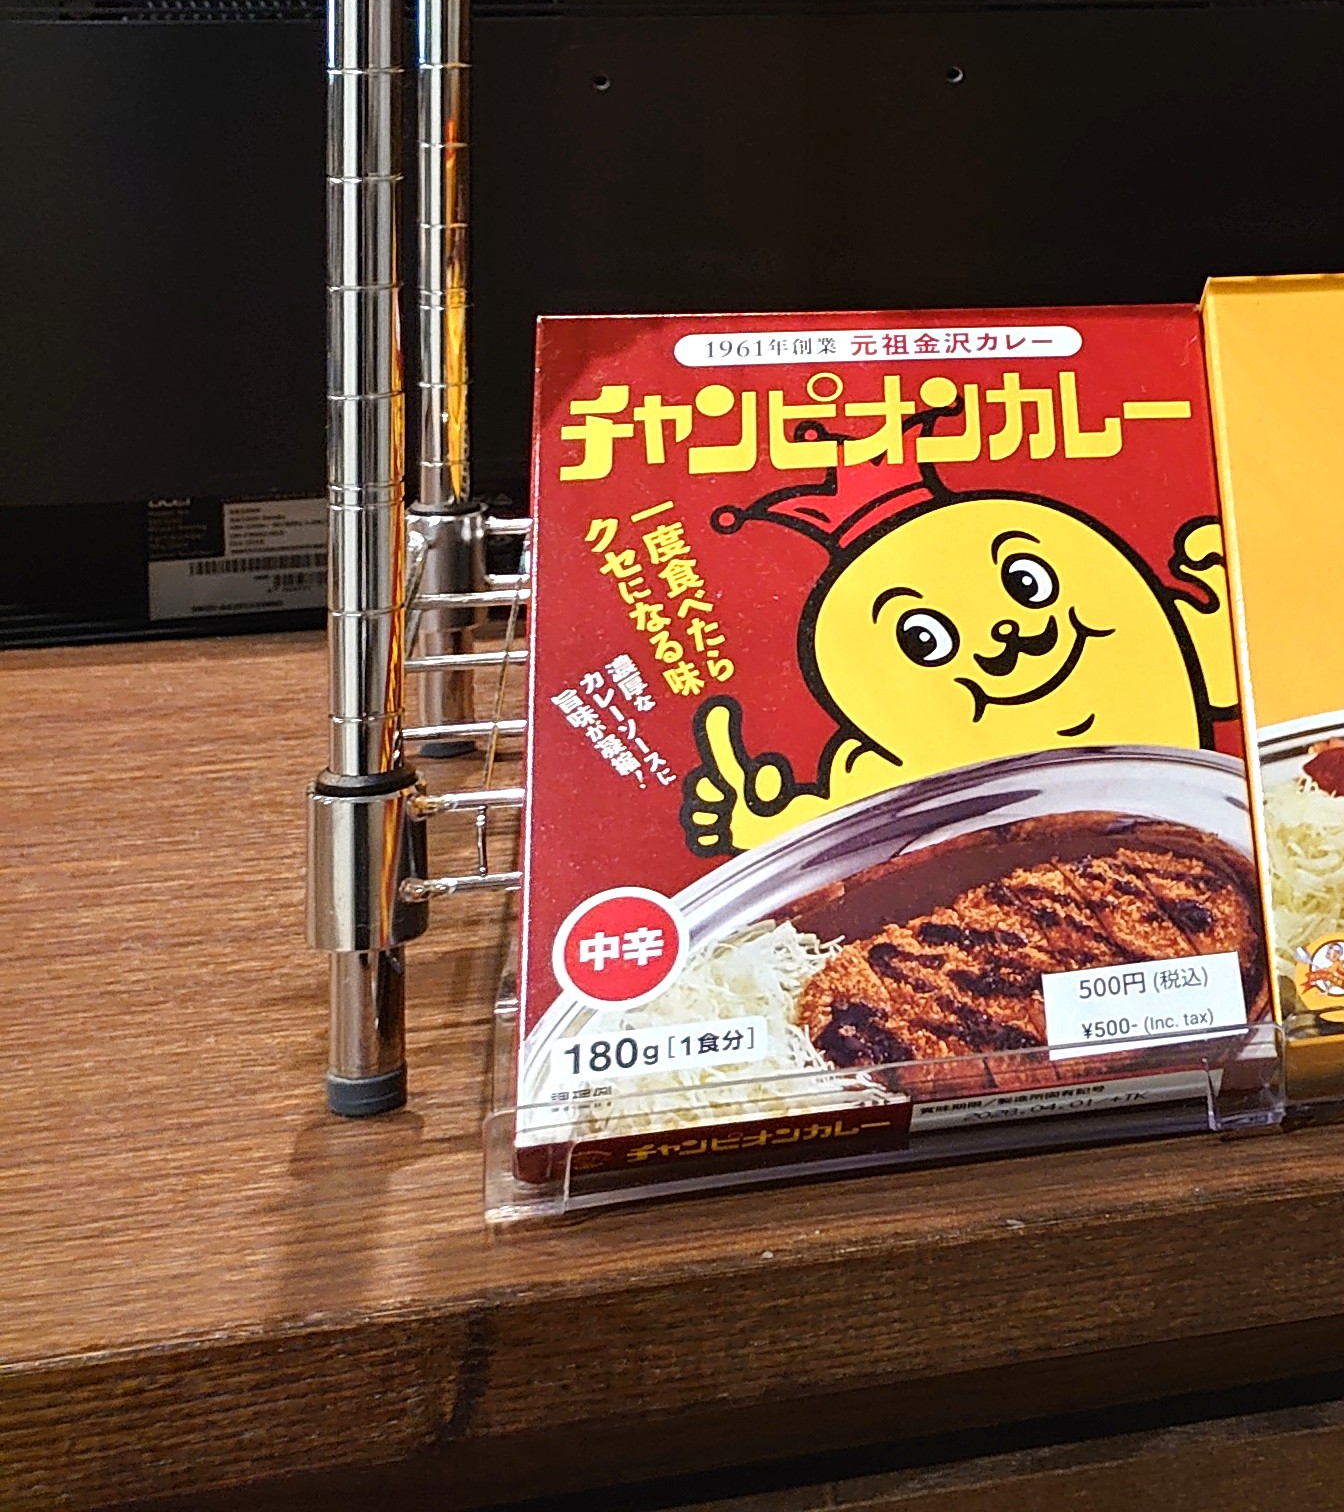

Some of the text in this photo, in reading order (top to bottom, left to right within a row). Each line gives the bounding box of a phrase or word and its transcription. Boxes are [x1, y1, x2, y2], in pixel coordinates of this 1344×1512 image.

[704, 331, 1055, 361] 1961年創業 元祖金沢カレー
[561, 371, 1192, 481] チャンピオンカレー
[584, 518, 705, 697] クセになる味
[630, 500, 735, 682] 一度食べたら
[580, 671, 677, 786] カレーソースに
[577, 925, 663, 972] 中辛
[1079, 966, 1208, 999] 500円 (税込)
[1082, 1008, 1214, 1039] ¥500- (Inc. tax)
[564, 1037, 659, 1075] 180g
[625, 1119, 892, 1164] チャンピオンカレー
